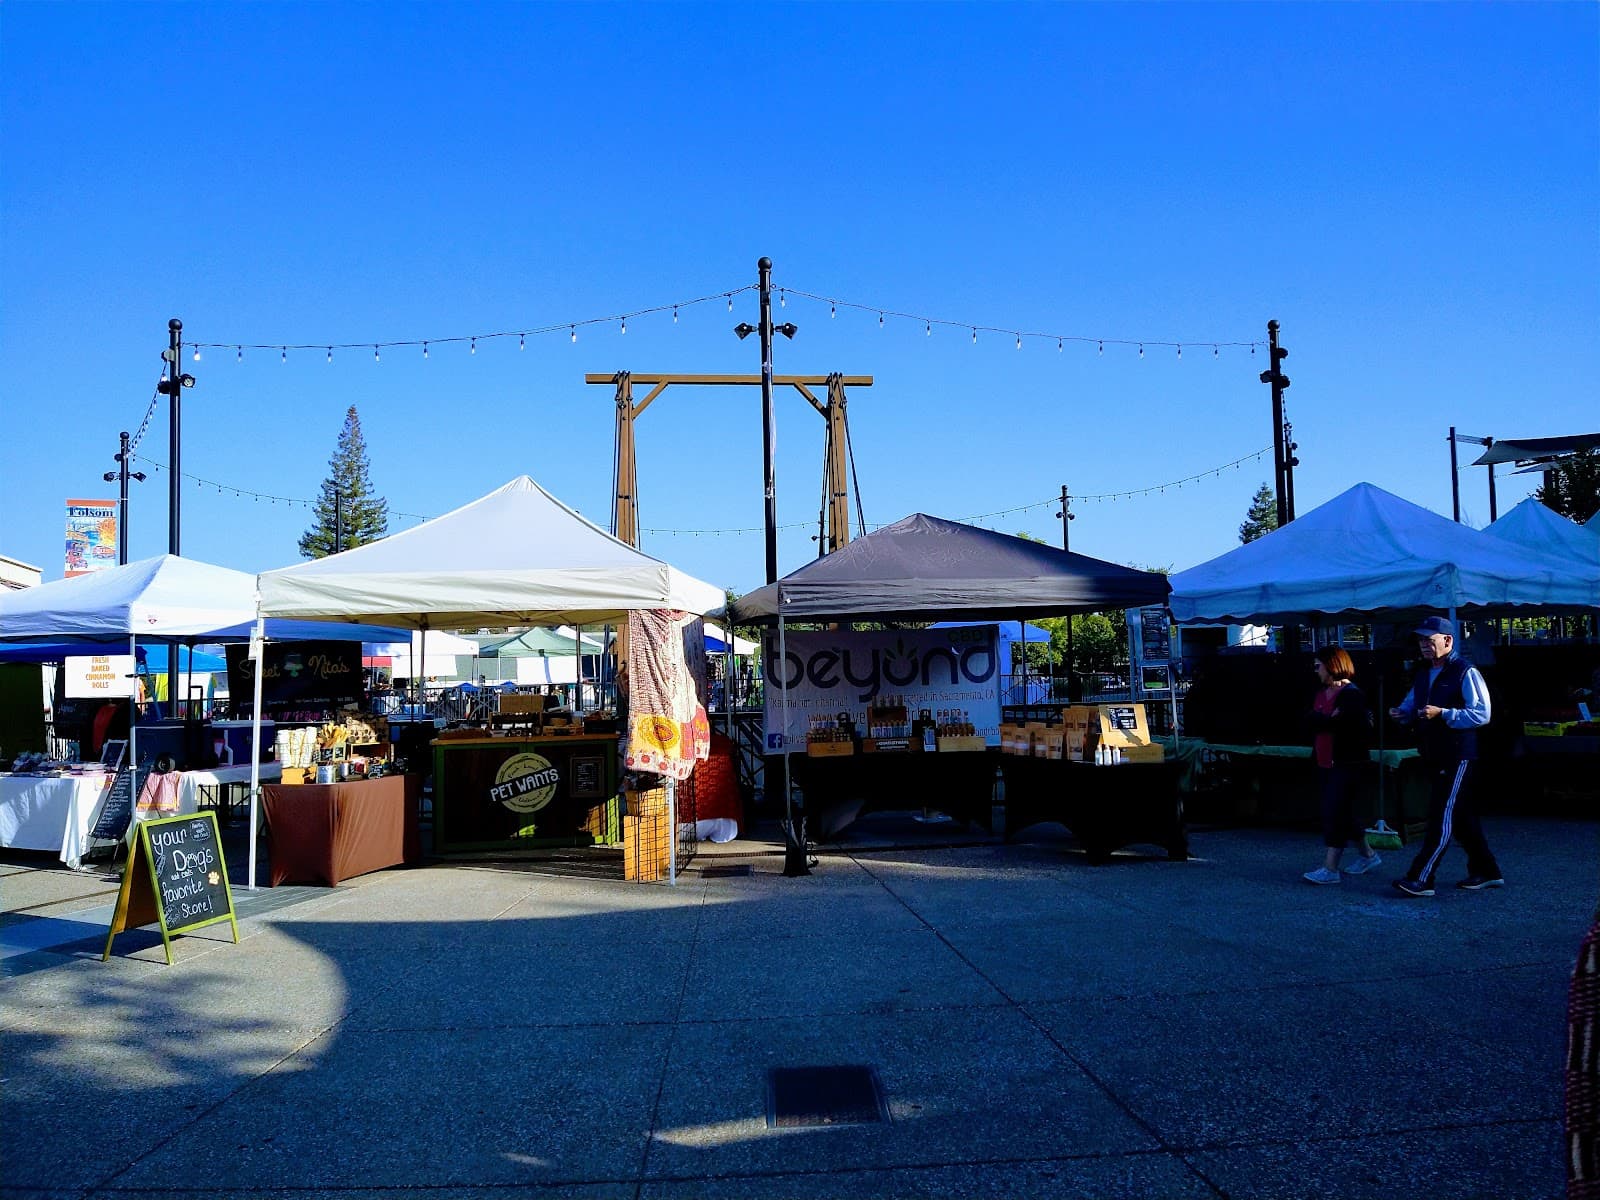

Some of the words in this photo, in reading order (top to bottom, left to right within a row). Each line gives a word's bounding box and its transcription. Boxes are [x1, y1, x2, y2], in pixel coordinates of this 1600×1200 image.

[69, 507, 114, 517] Folsom
[92, 656, 110, 664] FRESH
[766, 635, 996, 703] beyond
[85, 673, 115, 681] CINNAMON
[92, 681, 109, 689] ROLLS
[490, 782, 514, 802] PET
[515, 768, 559, 794] WANTS
[151, 828, 187, 857] your
[172, 846, 214, 874] Dog's
[162, 878, 204, 905] favorite
[181, 895, 214, 919] Store!
